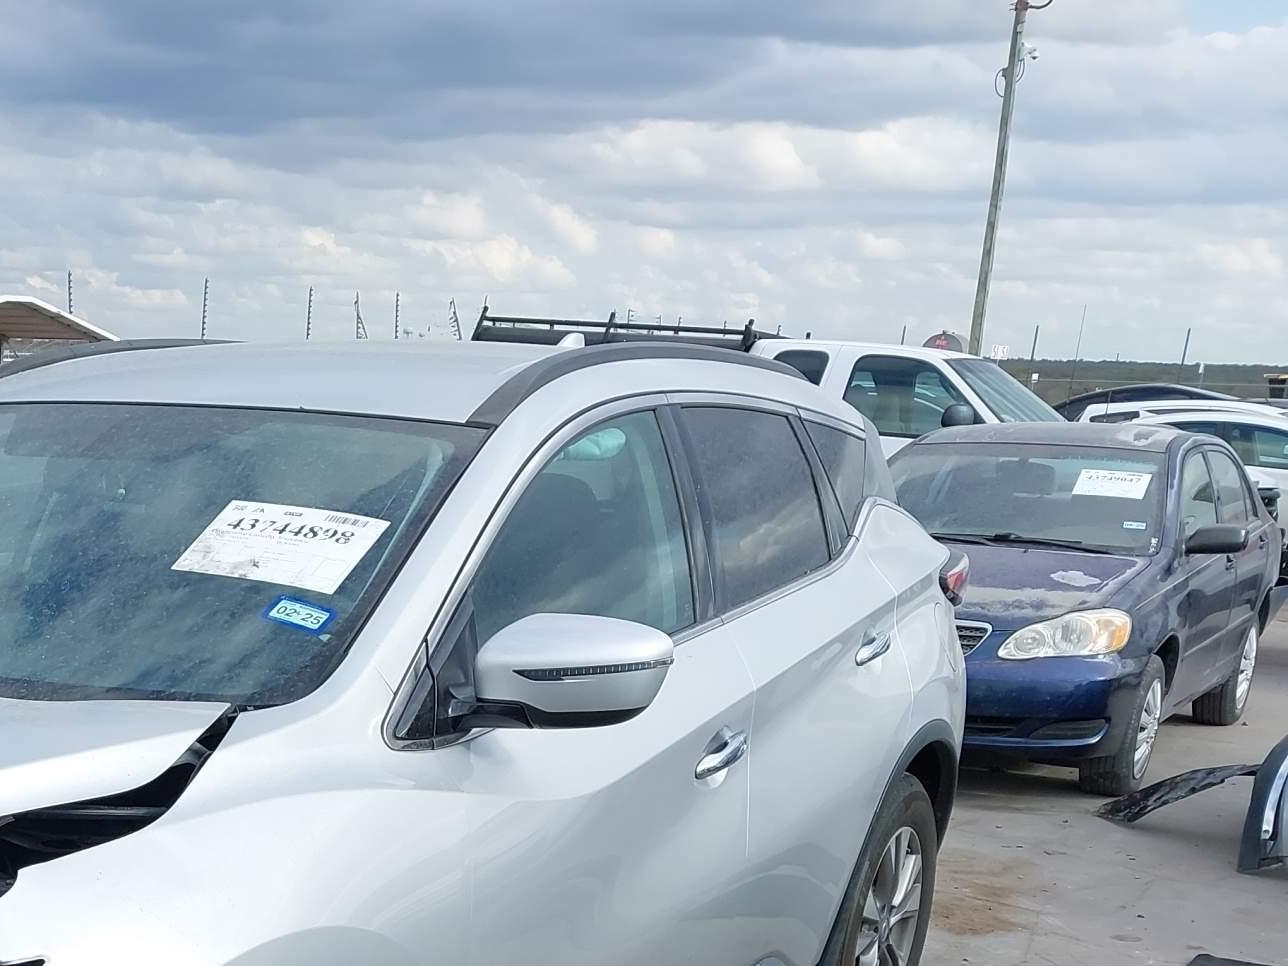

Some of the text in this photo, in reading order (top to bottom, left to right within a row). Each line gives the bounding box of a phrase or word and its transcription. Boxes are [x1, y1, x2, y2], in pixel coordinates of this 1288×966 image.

[227, 517, 355, 545] 43744898
[276, 605, 297, 618] 02
[301, 612, 324, 625] 25
